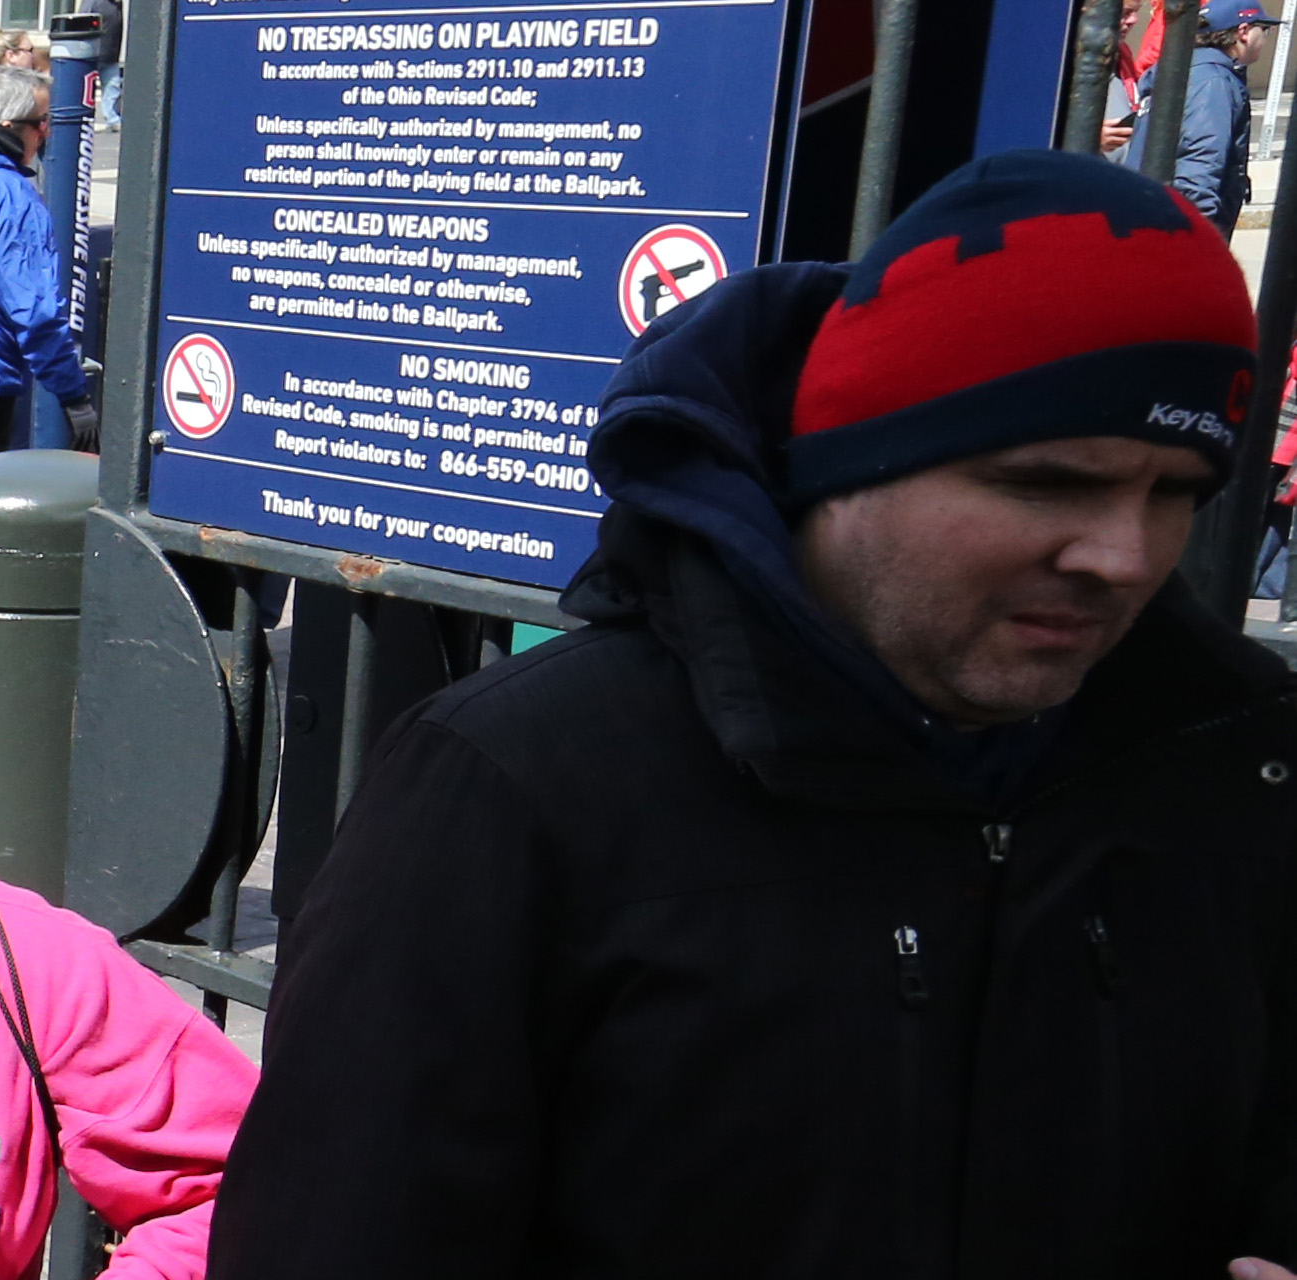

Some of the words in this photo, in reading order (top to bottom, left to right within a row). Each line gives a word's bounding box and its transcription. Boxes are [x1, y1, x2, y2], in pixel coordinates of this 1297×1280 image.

[258, 26, 286, 51] NO
[290, 23, 434, 51] TRESPASSING
[437, 22, 471, 50] ON
[475, 20, 579, 49] PLAYING
[583, 17, 659, 46] FIELD
[262, 61, 277, 79] In
[279, 61, 359, 79] accordance
[361, 60, 394, 79] with
[396, 60, 463, 79] Sections
[465, 58, 533, 78] 2911.10
[535, 58, 568, 78] and
[571, 57, 646, 78] 2911.13
[342, 86, 358, 105] of
[359, 87, 384, 105] the
[387, 86, 422, 105] Ohio
[424, 86, 487, 106] Revised
[490, 86, 538, 108] Code;
[256, 116, 303, 134] Unless
[306, 116, 387, 139] specifically
[389, 117, 473, 137] authorized
[475, 119, 496, 141] by
[498, 120, 614, 143] management,
[618, 124, 642, 140] no
[265, 143, 314, 162] person
[316, 142, 352, 160] shall
[354, 143, 431, 166] knowingly
[433, 147, 477, 164] enter
[479, 149, 497, 165] or
[500, 147, 560, 166] remain
[563, 151, 585, 167] on
[588, 152, 624, 171] any
[244, 166, 312, 184] restricted
[313, 168, 366, 188] portion
[368, 169, 384, 187] of
[385, 170, 411, 188] the
[412, 171, 471, 195] playing
[474, 172, 511, 193] field
[513, 175, 531, 193] at
[533, 174, 562, 194] the
[565, 175, 647, 199] Ballpark.
[274, 208, 384, 236] CONCEALED
[387, 214, 489, 242] WEAPONS
[198, 232, 248, 254] Unless
[250, 238, 338, 265] specifically
[340, 245, 428, 267] authorized
[432, 248, 453, 272] by
[456, 253, 583, 279] management,
[69, 266, 89, 332] FIELD
[231, 266, 251, 282] no
[253, 268, 325, 290] weapons,
[328, 273, 411, 295] concealed
[414, 280, 433, 296] or
[436, 278, 532, 306] otherwise,
[249, 294, 275, 311] are
[278, 296, 354, 319] permitted
[357, 300, 389, 321] into
[391, 304, 419, 324] the
[422, 304, 503, 333] Ballpark.
[400, 354, 430, 379] NO
[433, 358, 531, 390] SMOKING
[284, 372, 300, 391] In
[302, 379, 393, 403] accordance
[396, 387, 433, 408] with
[436, 389, 507, 418] Chapter
[510, 397, 558, 422] 3794
[561, 404, 583, 426] of
[242, 393, 301, 419] Revised
[304, 401, 347, 428] Code,
[349, 412, 420, 440] smoking
[423, 417, 439, 438] is
[442, 422, 471, 442] not
[473, 428, 565, 454] permitted
[568, 434, 588, 457] in
[275, 429, 327, 456] Report
[330, 438, 401, 467] violators
[404, 449, 428, 470] to:
[439, 450, 590, 492] 866-559-OHIO
[261, 489, 315, 520] Thank
[317, 503, 351, 527] you
[354, 506, 383, 532] for
[385, 515, 431, 538] your
[432, 523, 555, 560] cooperation
